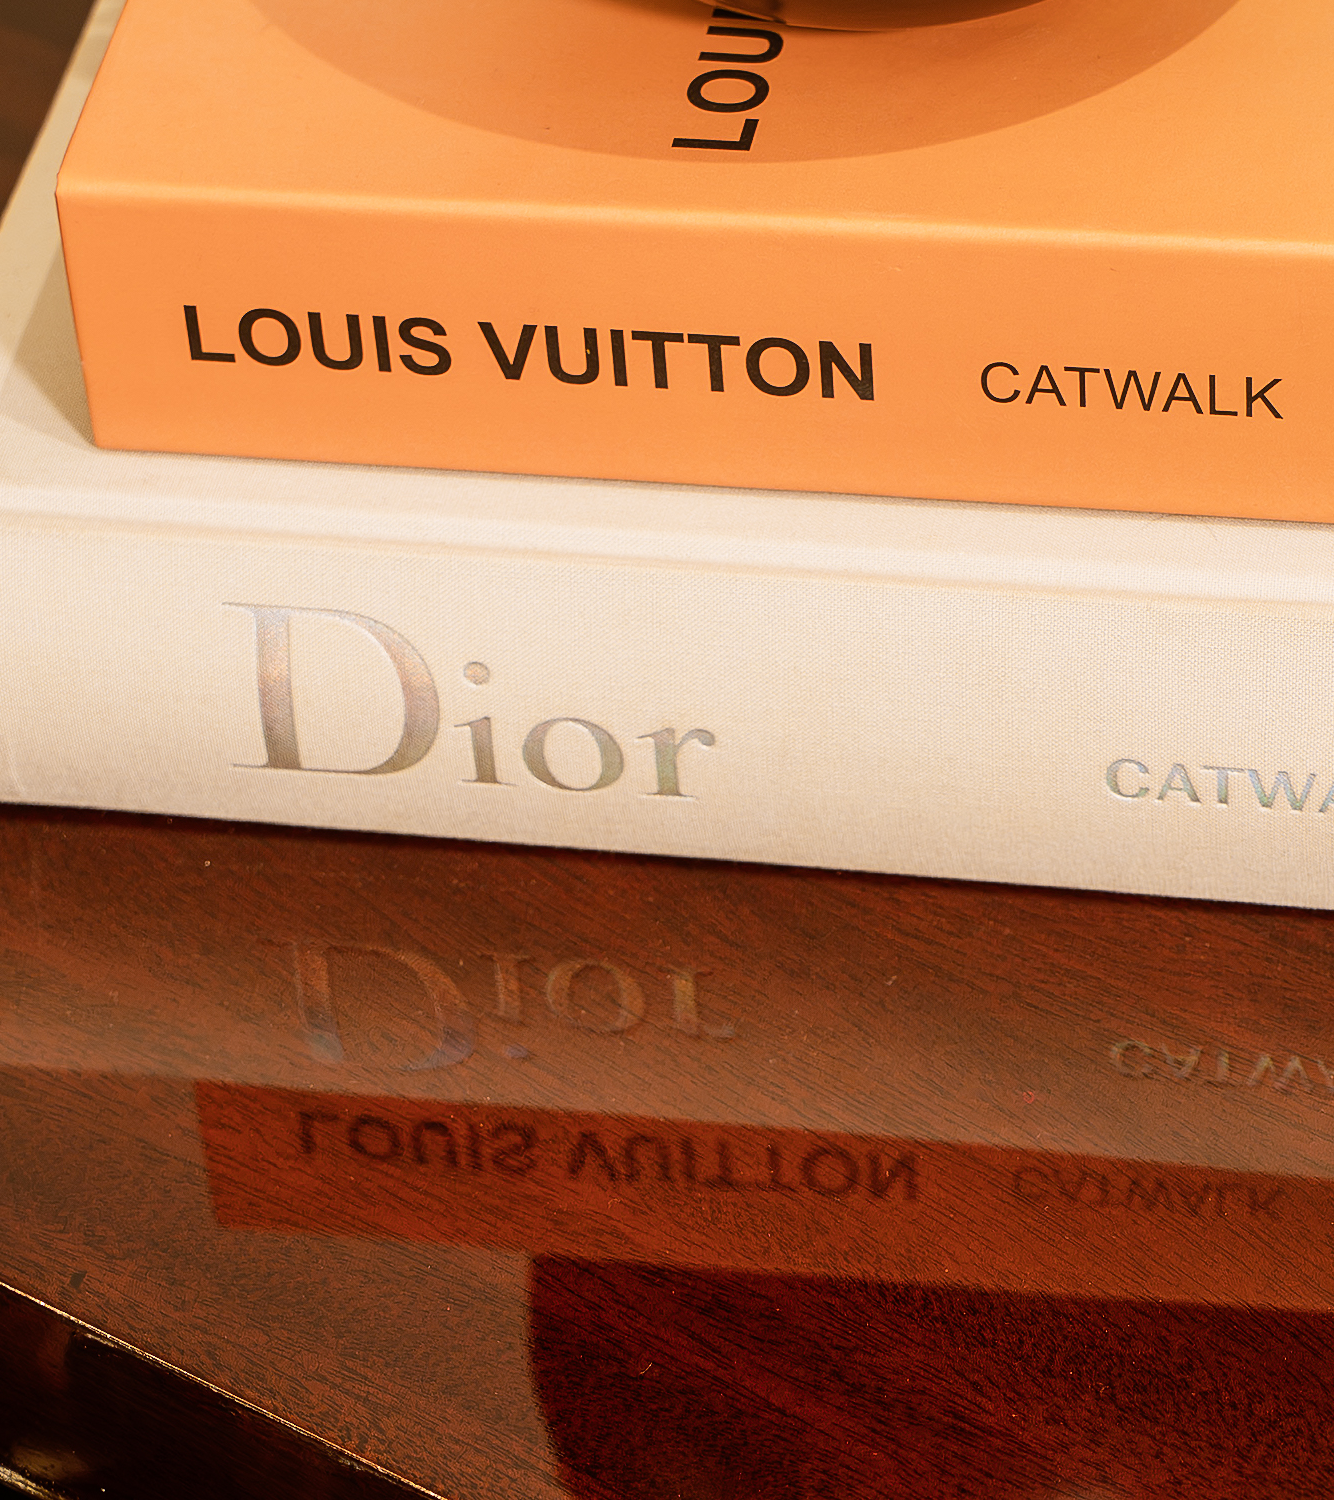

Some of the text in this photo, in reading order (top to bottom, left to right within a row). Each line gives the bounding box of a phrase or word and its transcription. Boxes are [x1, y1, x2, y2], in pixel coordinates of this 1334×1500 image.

[183, 304, 876, 402] LOUIS VUITTON
[980, 361, 1284, 420] CATWALK
[221, 601, 717, 799] Dior
